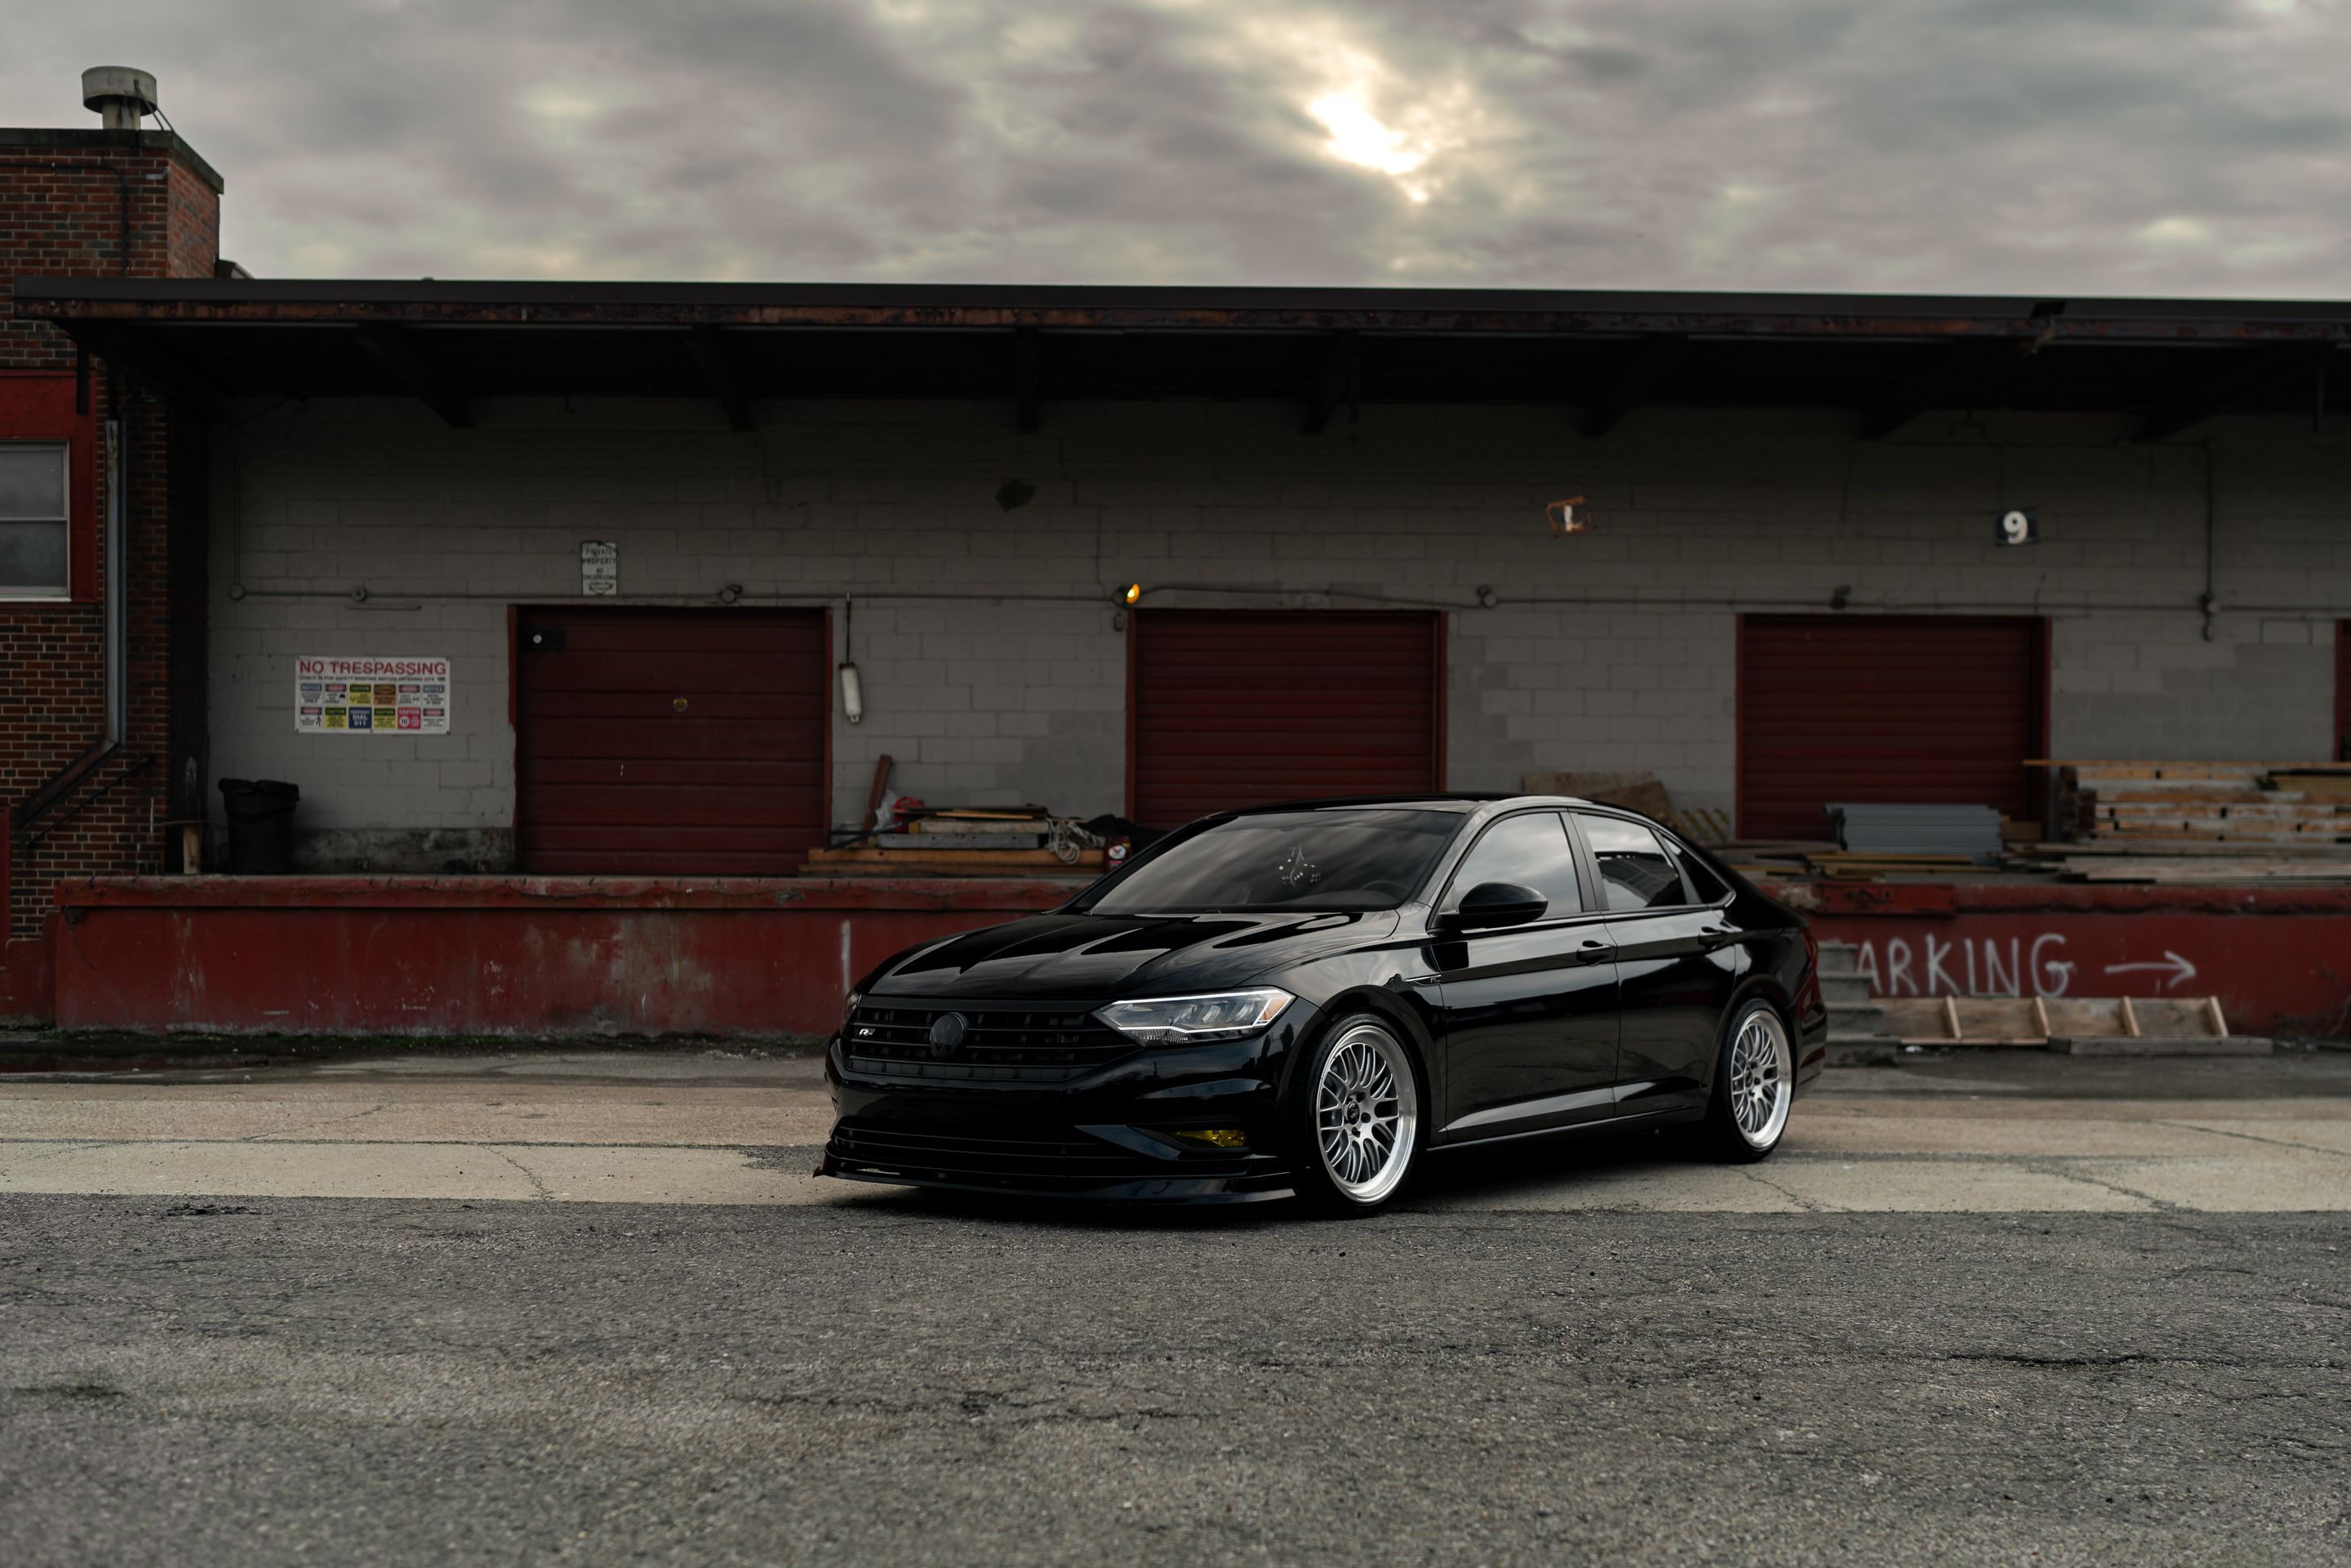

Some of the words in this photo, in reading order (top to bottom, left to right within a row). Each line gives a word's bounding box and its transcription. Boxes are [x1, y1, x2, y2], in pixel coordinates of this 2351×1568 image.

[2003, 510, 2028, 544] 9
[300, 660, 324, 674] NO
[329, 661, 446, 676] TRESPASSING
[1857, 933, 2075, 998] ARKING
